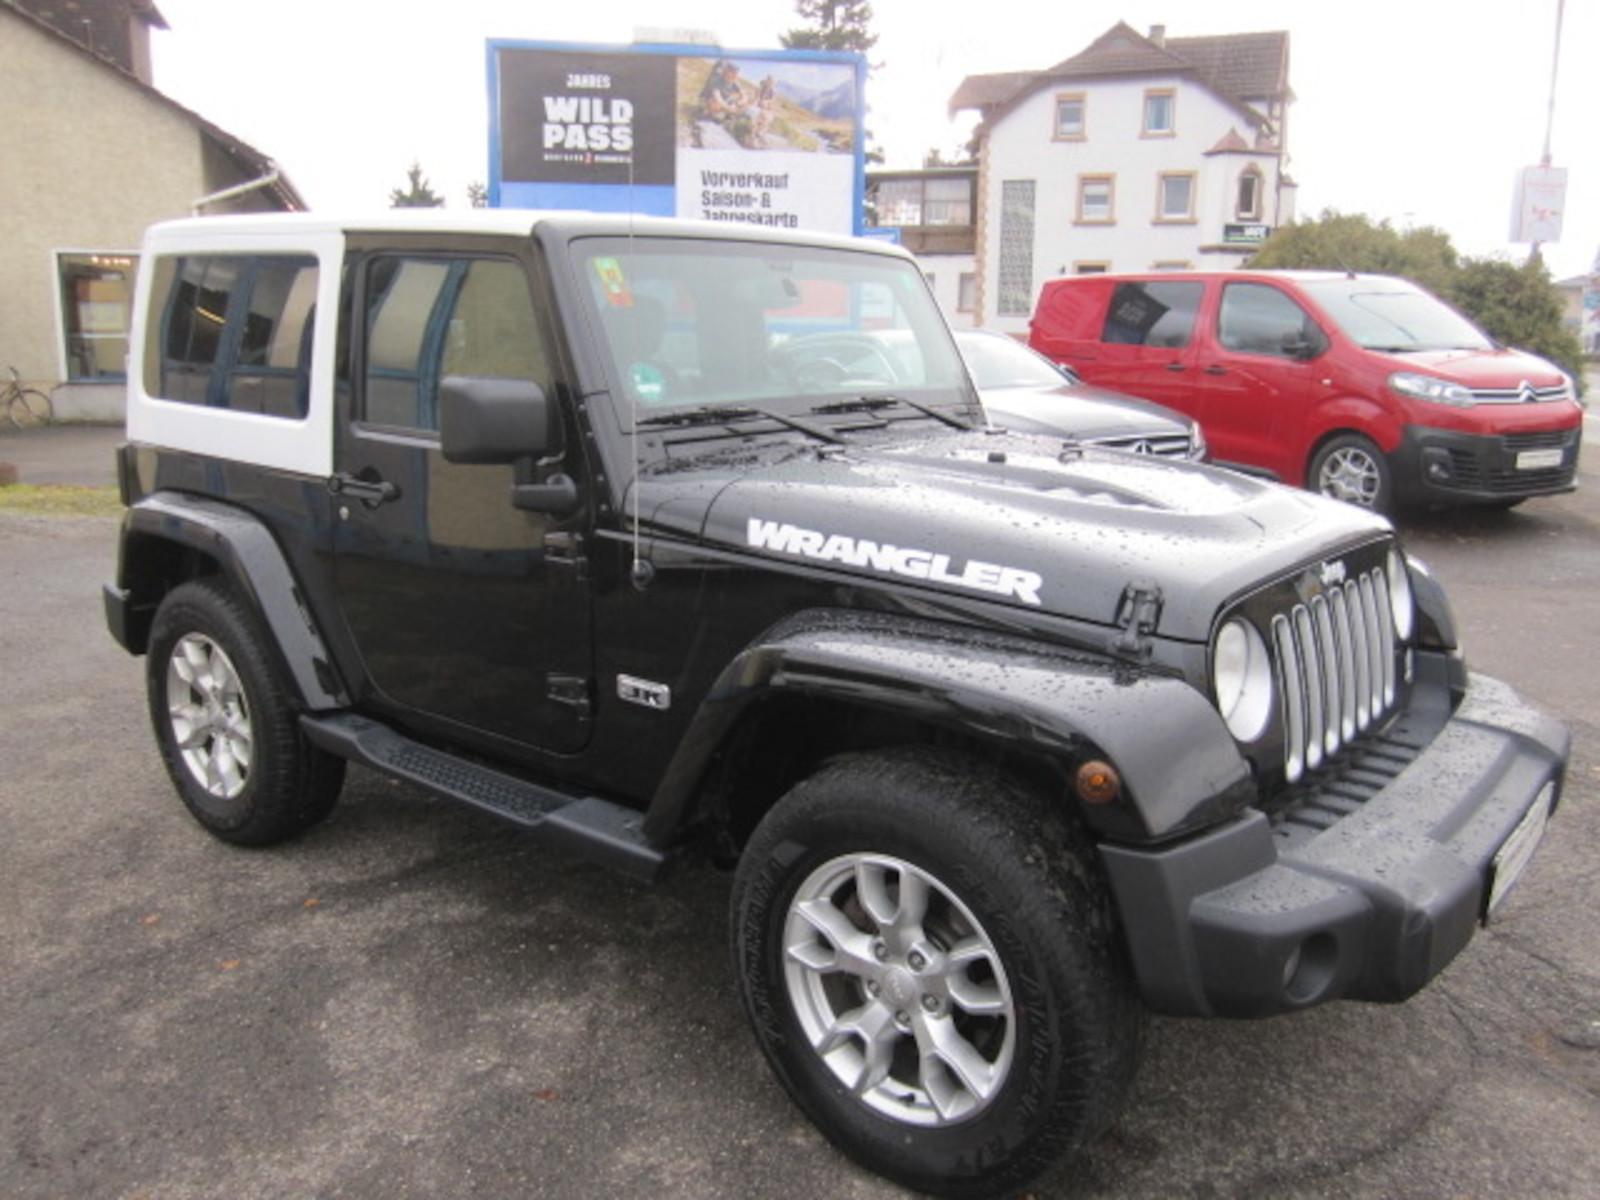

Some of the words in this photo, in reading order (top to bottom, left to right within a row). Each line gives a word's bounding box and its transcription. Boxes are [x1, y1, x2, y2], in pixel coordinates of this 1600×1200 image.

[543, 96, 634, 124] WILD
[543, 123, 634, 151] PASS
[700, 170, 789, 189] Vorverkauf
[701, 190, 758, 207] Saison-
[747, 517, 1042, 606] WRANGLER
